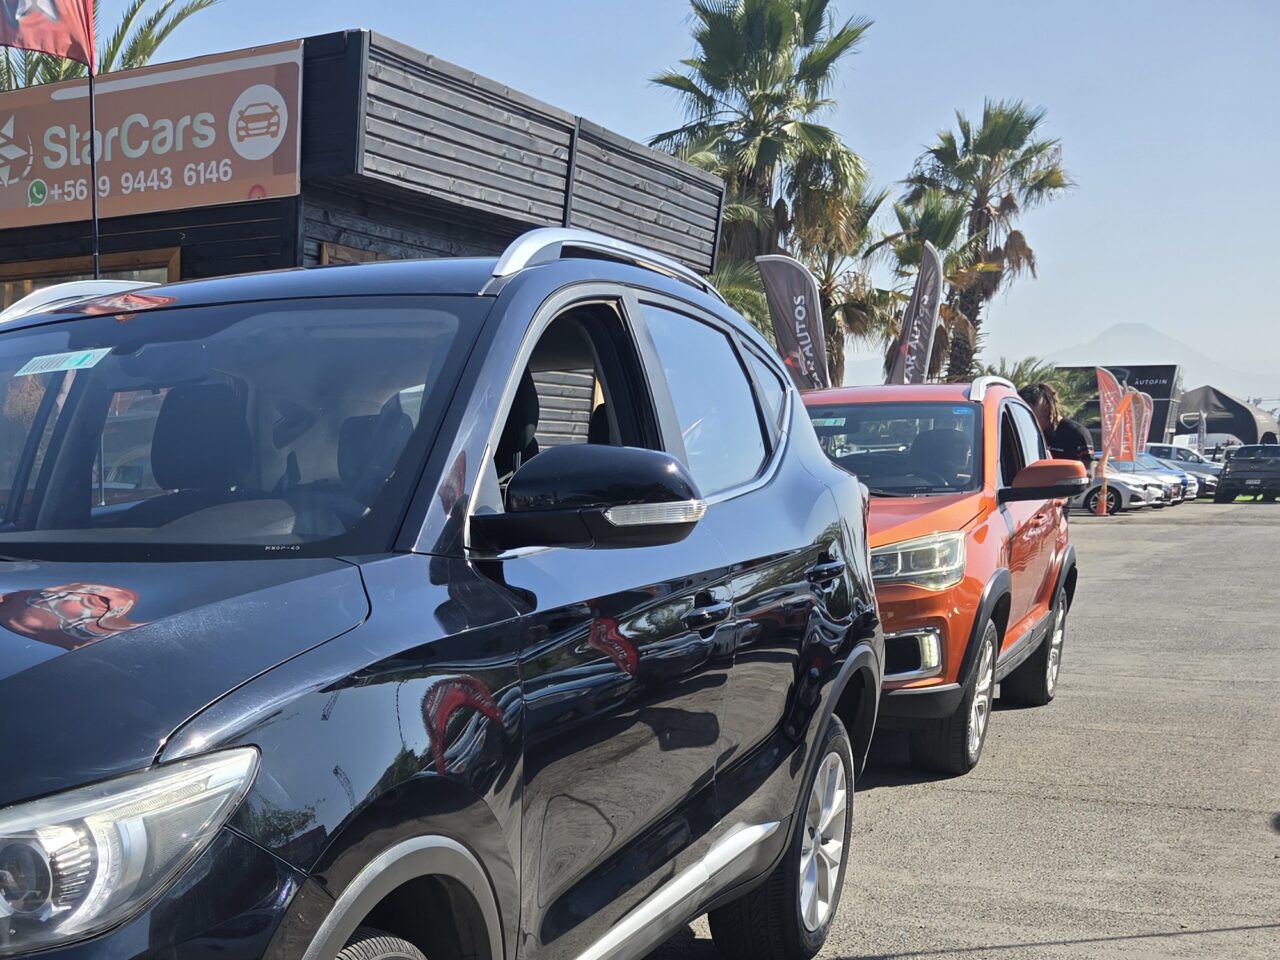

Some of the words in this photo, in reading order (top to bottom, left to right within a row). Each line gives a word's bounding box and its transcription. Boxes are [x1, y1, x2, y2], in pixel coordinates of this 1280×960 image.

[43, 112, 217, 169] StarCars
[50, 178, 88, 201] +56
[98, 175, 110, 198] 9
[121, 167, 173, 195] 9443
[183, 158, 233, 187] 6146
[793, 295, 815, 359] AUTOS
